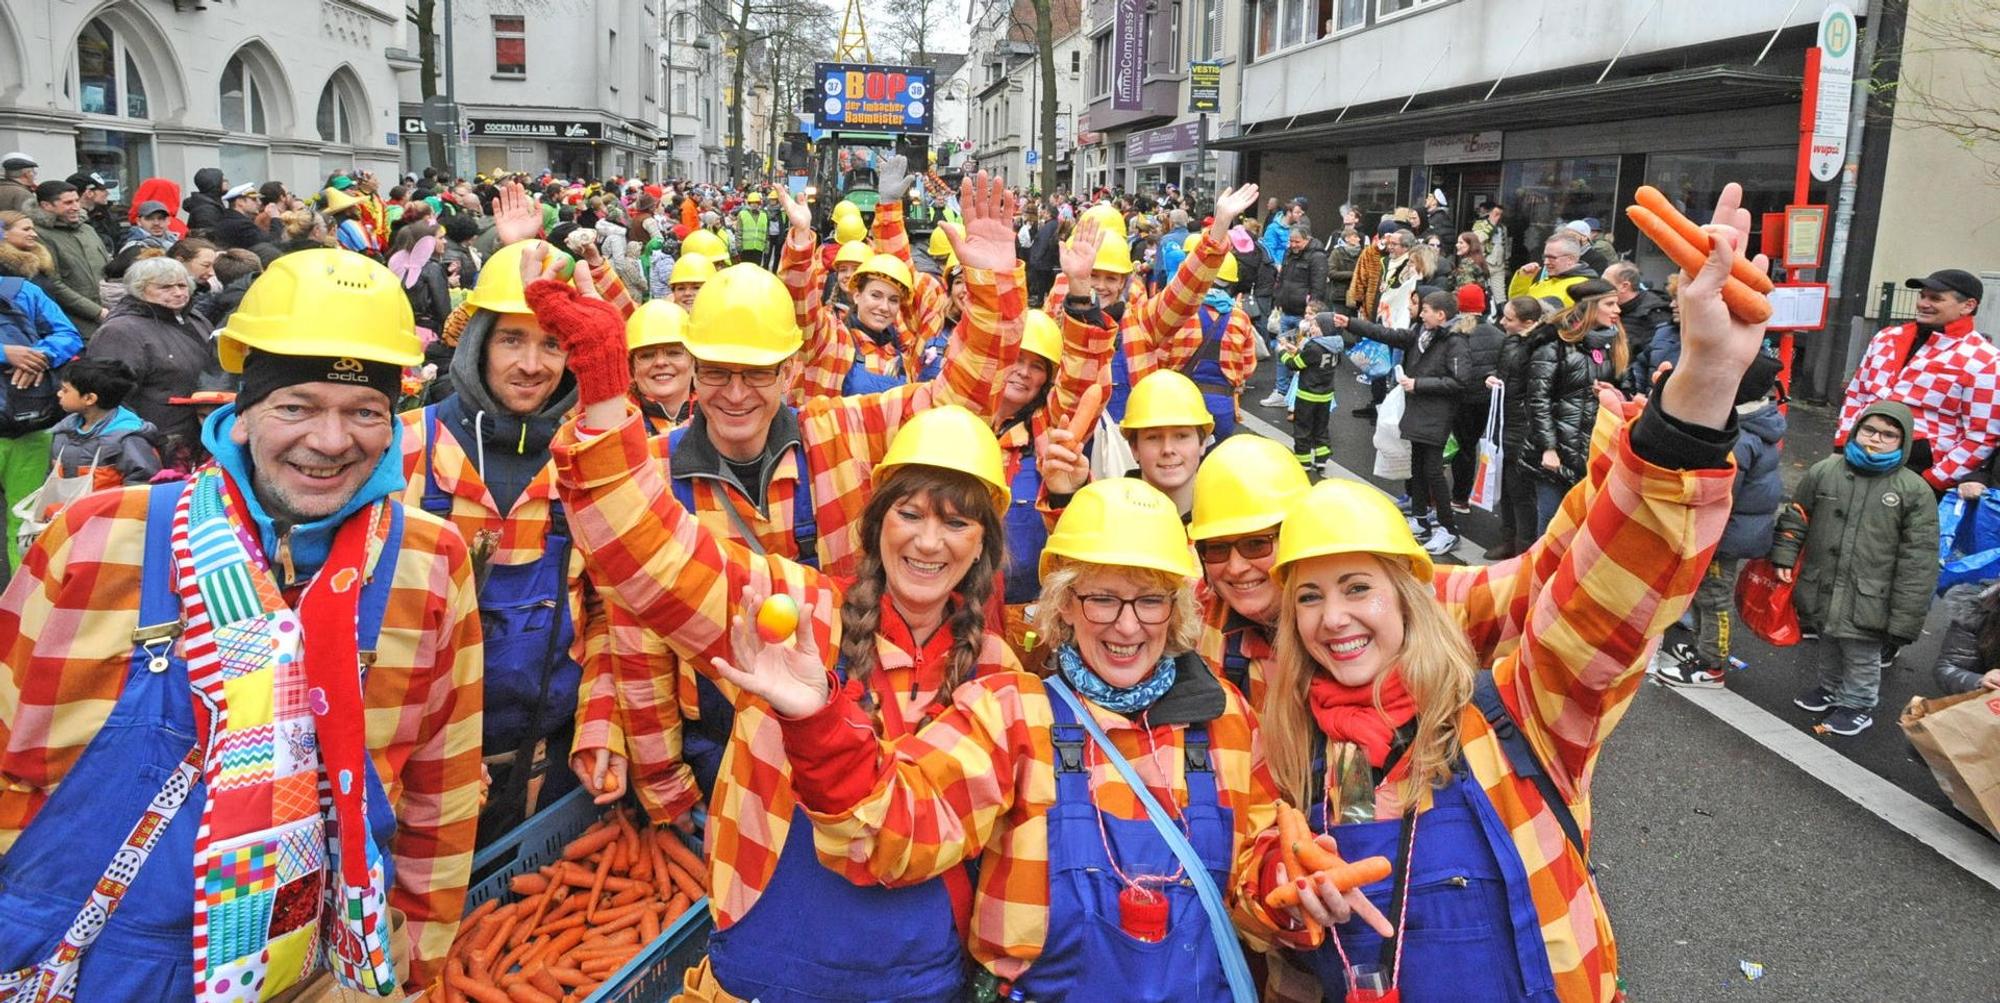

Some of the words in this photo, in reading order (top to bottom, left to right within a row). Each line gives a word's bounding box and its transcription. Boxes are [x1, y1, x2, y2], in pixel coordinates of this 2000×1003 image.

[1120, 11, 1135, 102] ImmoCompass
[1191, 65, 1220, 74] VESTIS
[827, 82, 839, 91] 37
[845, 71, 906, 100] BOP
[845, 101, 862, 111] der
[844, 111, 905, 126] Baumeister
[484, 123, 530, 132] COCKTAILS
[531, 124, 538, 132] &
[539, 124, 556, 132] BAR
